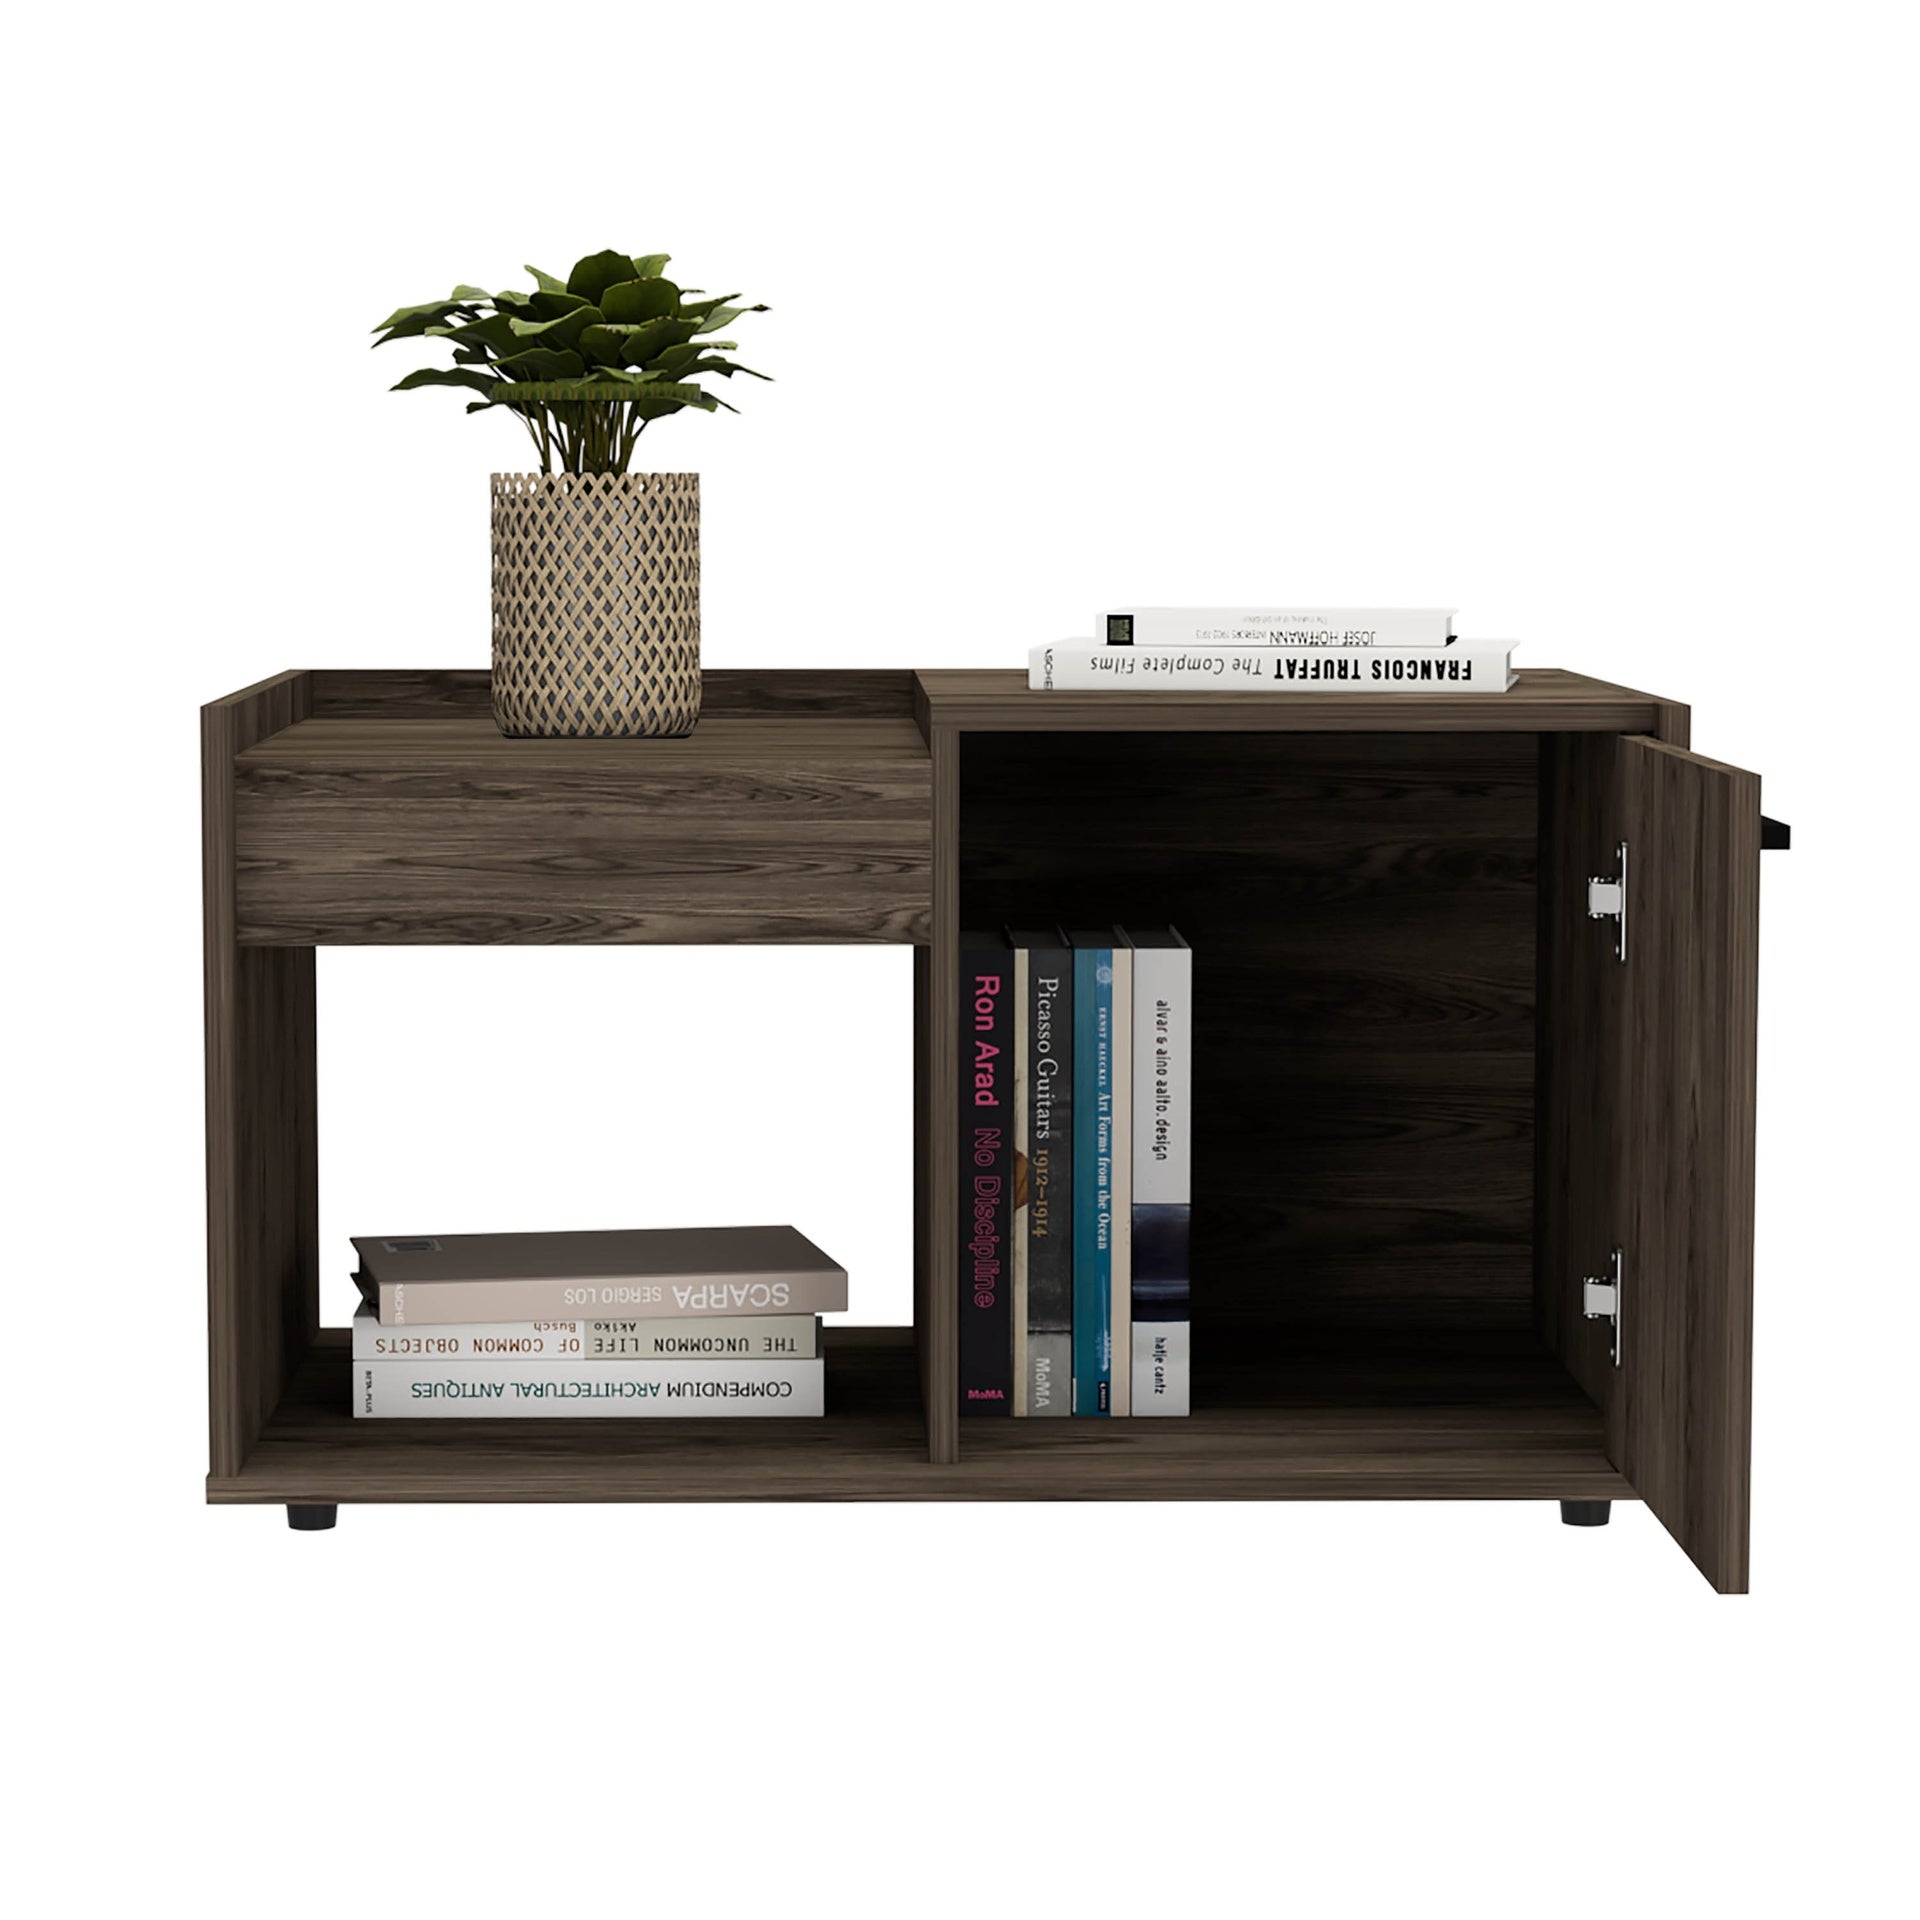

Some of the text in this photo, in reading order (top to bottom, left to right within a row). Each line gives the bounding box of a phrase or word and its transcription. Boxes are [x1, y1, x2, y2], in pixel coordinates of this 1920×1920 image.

[1270, 630, 1338, 645] HOFFMANN
[1343, 630, 1375, 645] JOSEF
[1090, 655, 1471, 679] FRANCOIS TRUFFAT The Complete Films
[1037, 977, 1059, 1053] Picasso
[1155, 1000, 1169, 1032] alvar
[1099, 1042, 1107, 1086] HAECKEL
[1155, 1049, 1170, 1076] aino
[1036, 1058, 1057, 1139] Guitars
[1098, 1092, 1112, 1112] Art
[970, 976, 1000, 1307] Ron Arad No Discipline
[1098, 1116, 1112, 1153] Forms
[1098, 1157, 1112, 1186] from
[1098, 1191, 1112, 1209] the
[1097, 1213, 1110, 1249] Ocean
[564, 1283, 789, 1307] SCARPA SERGIO LOS
[534, 1322, 636, 1333] Akiko Busch
[375, 1337, 797, 1353] THE UNCOMMON LIFE OF COMMON OBJECTS
[1153, 1337, 1167, 1394] hatje cantz
[412, 1381, 792, 1397] COMPENDIUM ARCHITECTURAL ANTIQUES
[968, 1389, 1004, 1399] MoMA
[1035, 1358, 1051, 1407] MoMA
